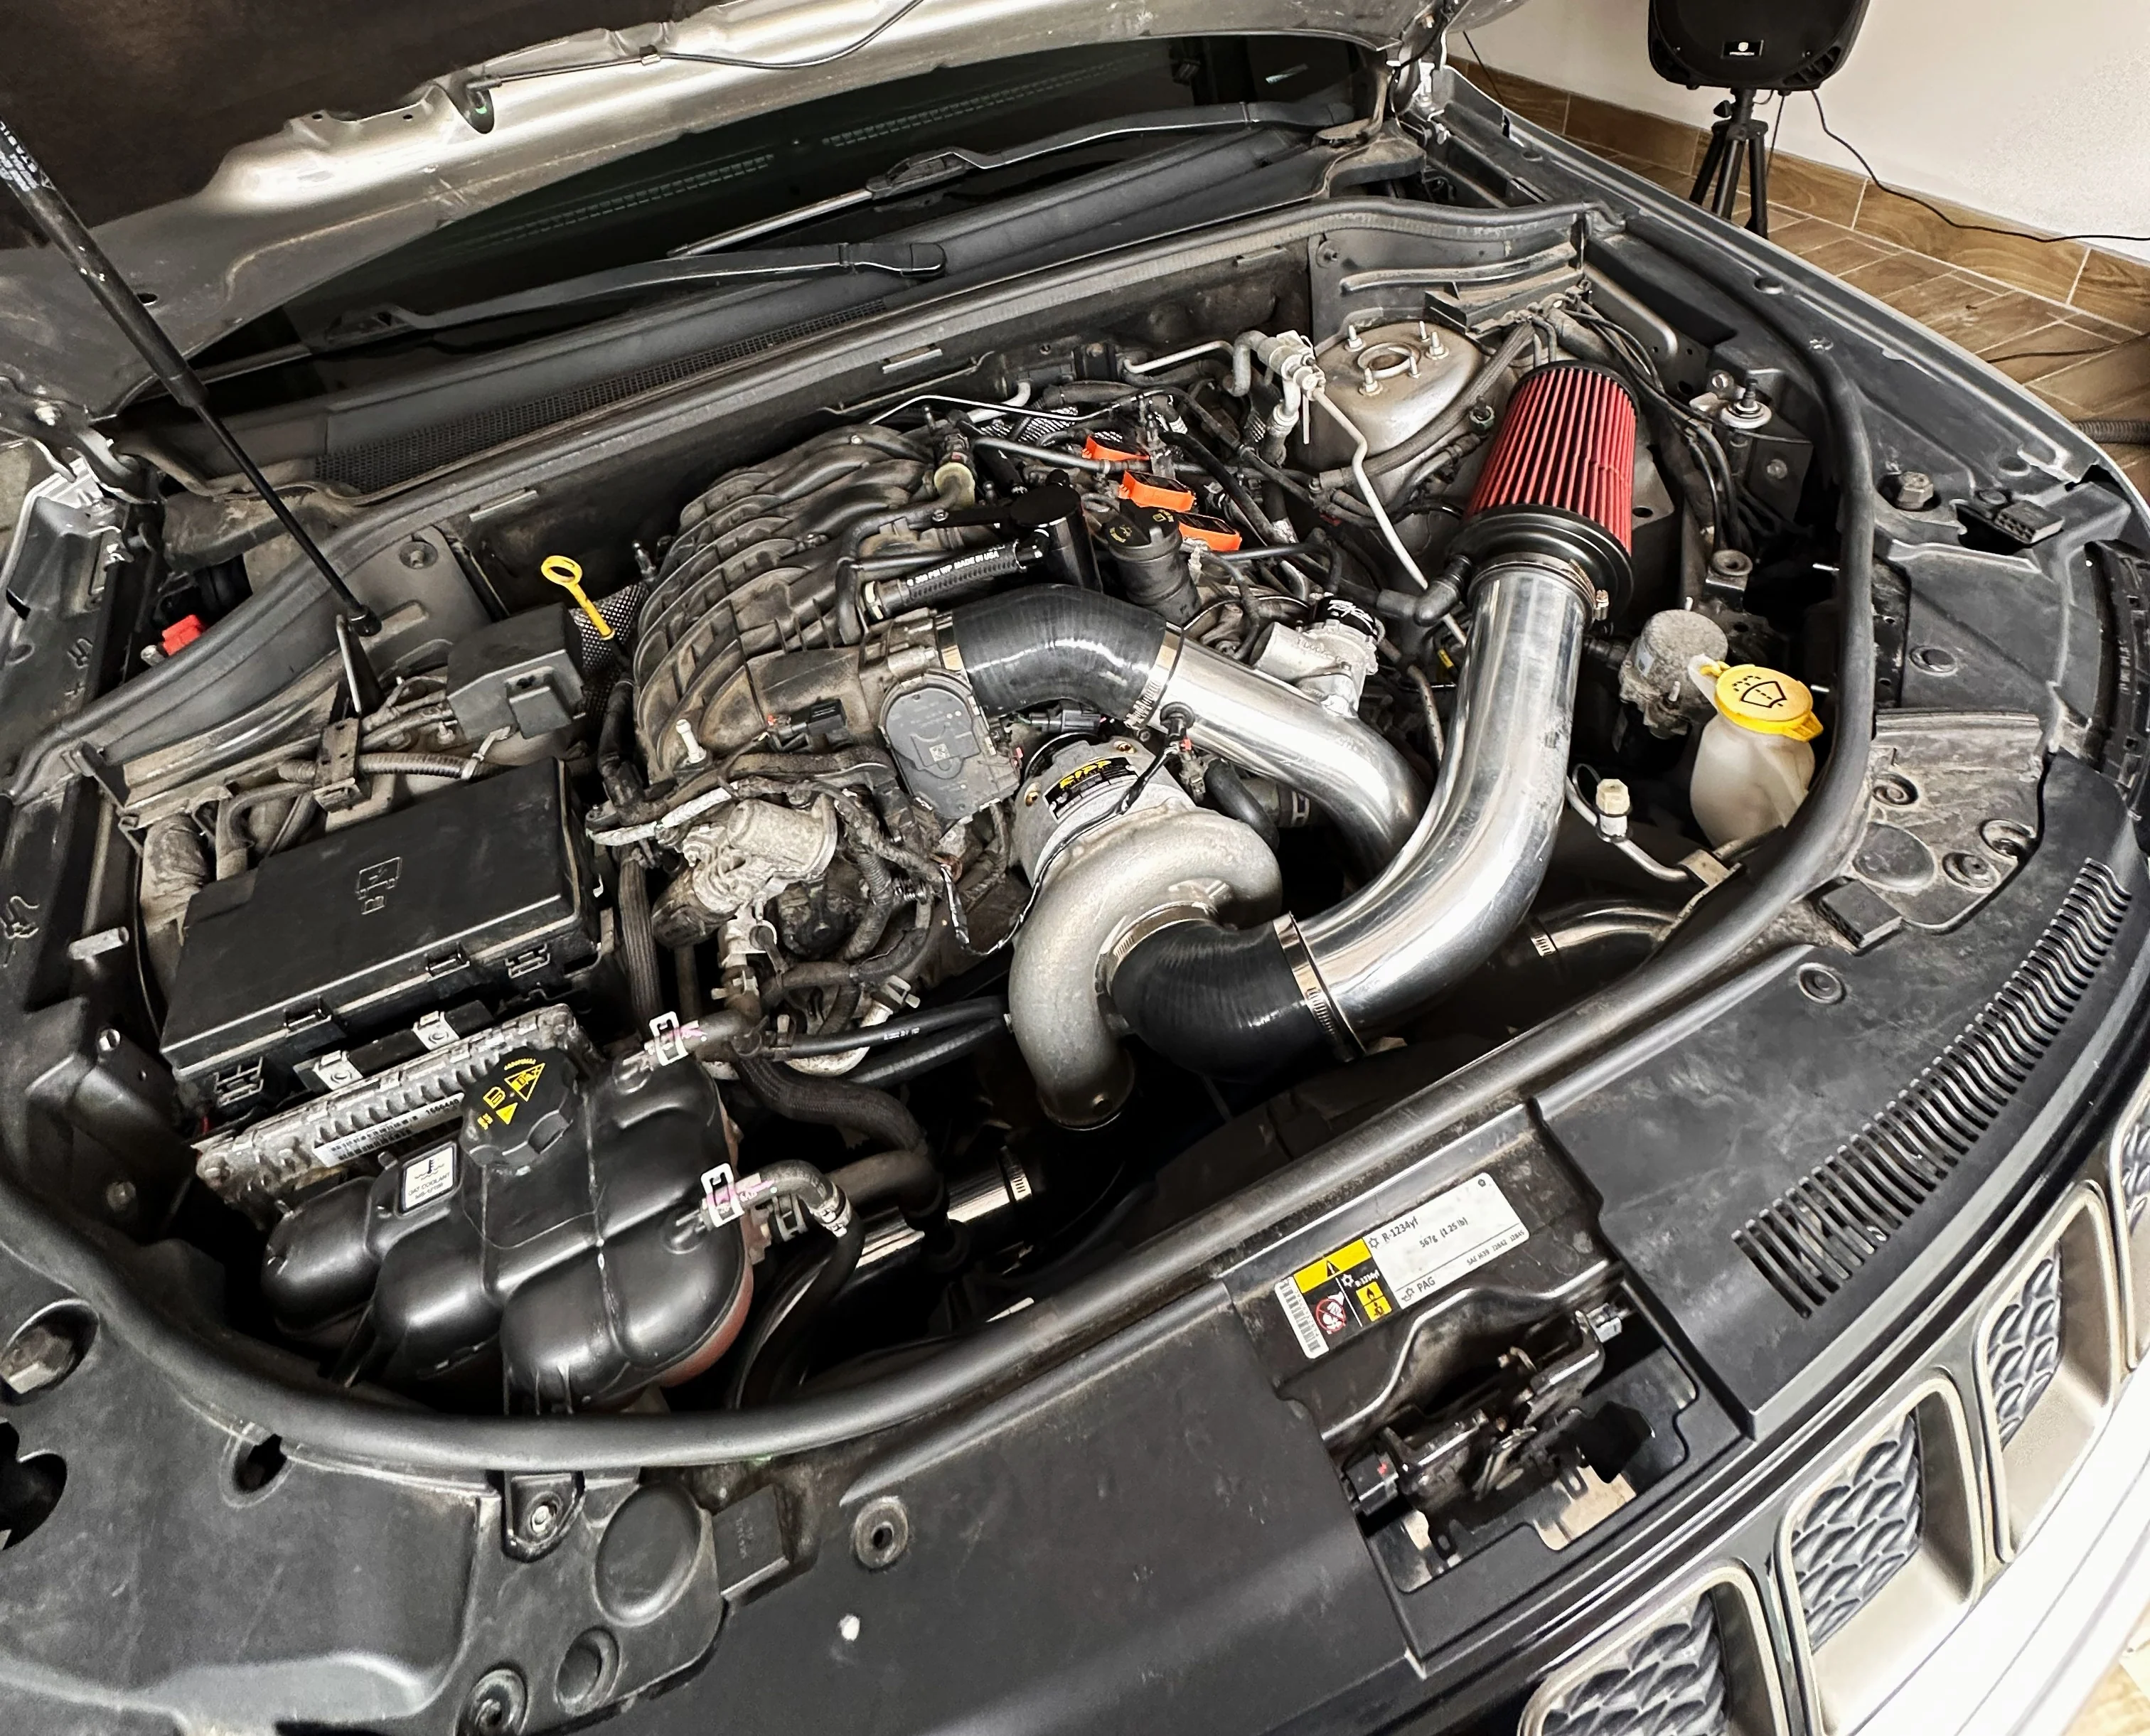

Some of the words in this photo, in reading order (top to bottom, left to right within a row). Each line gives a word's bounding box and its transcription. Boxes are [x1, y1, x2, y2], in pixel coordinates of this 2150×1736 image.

[928, 569, 941, 579] PSI
[939, 564, 953, 574] WP
[953, 557, 975, 569] MADE
[975, 554, 984, 563] IN
[983, 550, 1000, 561] USA
[421, 1172, 450, 1190] COOLANT
[1381, 1216, 1419, 1243] R-1234yf
[1419, 1235, 1438, 1248] 567g
[1439, 1222, 1458, 1238] (1.25
[1456, 1216, 1469, 1227] lb)
[1416, 1276, 1436, 1293] PAG
